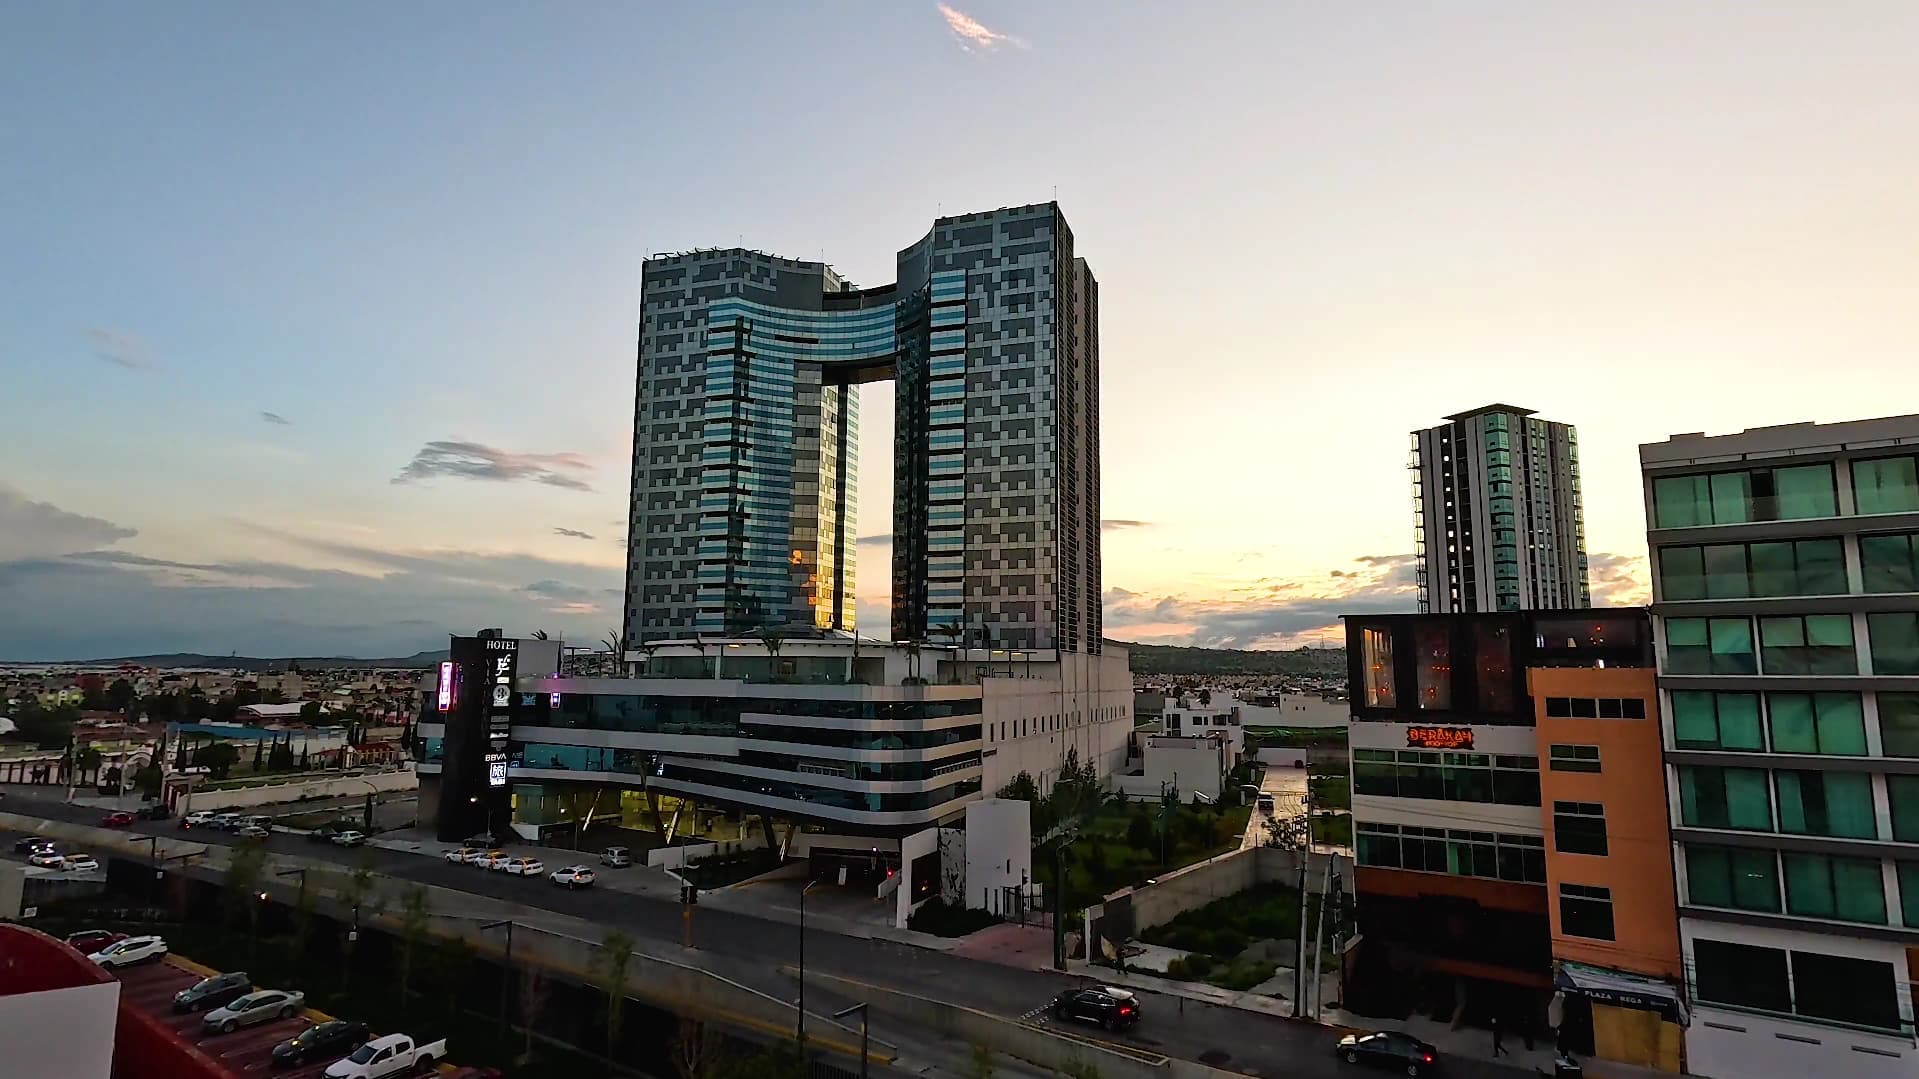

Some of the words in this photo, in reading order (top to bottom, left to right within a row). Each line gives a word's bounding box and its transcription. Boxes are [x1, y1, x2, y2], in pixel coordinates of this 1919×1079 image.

[486, 640, 517, 650] HOTEL
[485, 753, 506, 762] BBVA
[1584, 991, 1612, 1000] PLAZA
